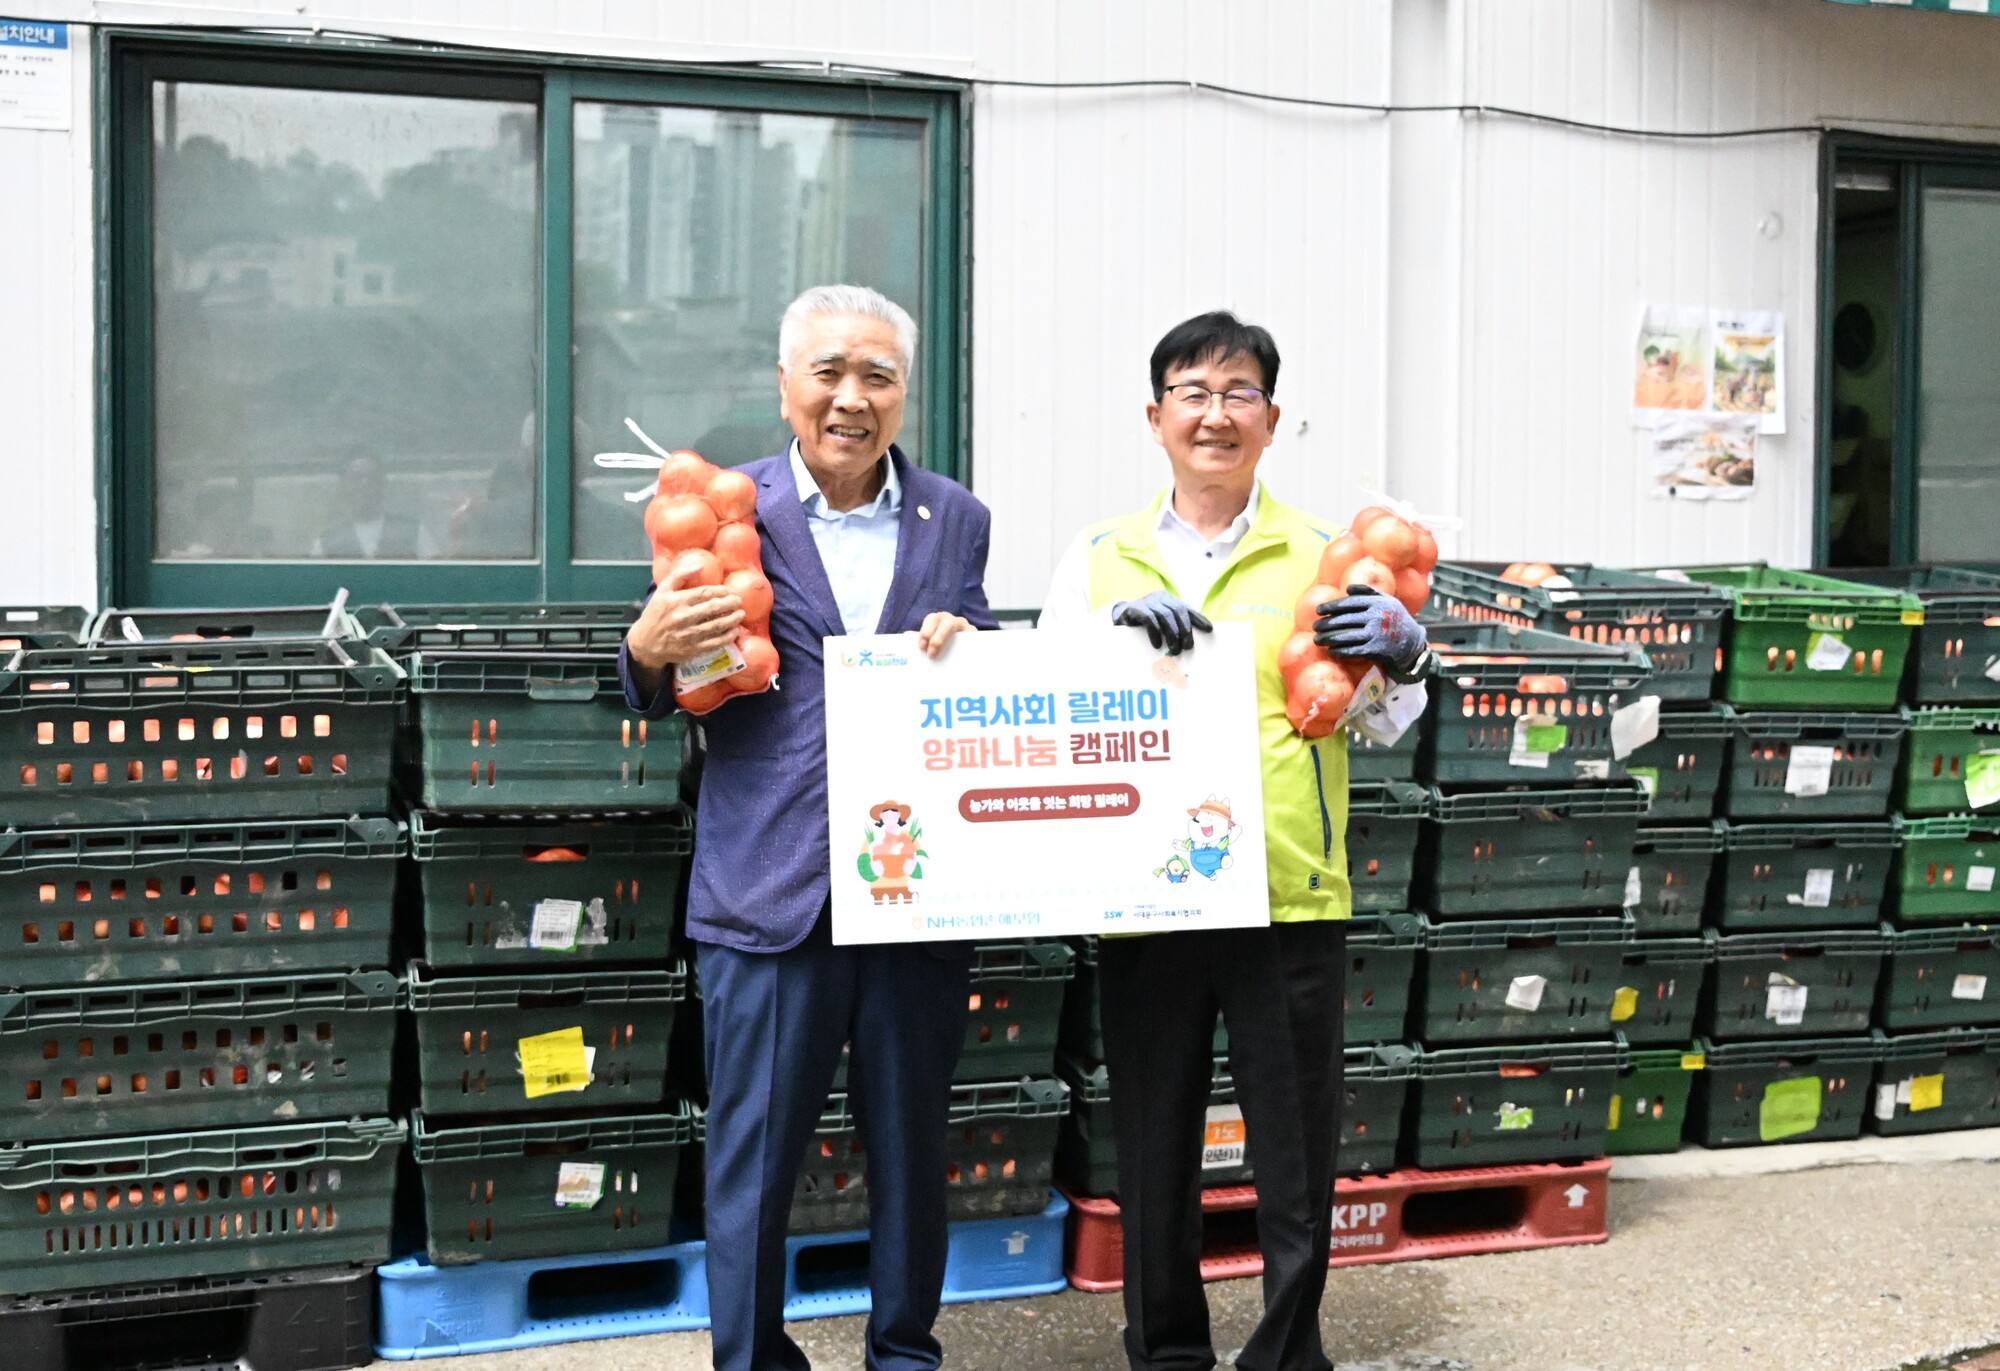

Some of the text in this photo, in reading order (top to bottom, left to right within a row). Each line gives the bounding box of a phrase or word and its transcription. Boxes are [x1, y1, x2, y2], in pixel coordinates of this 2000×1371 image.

[920, 688, 1168, 729] 지역사회 릴레이
[923, 729, 1171, 771] 양파나눔 캠페인
[969, 792, 1129, 813] 농가와 이웃을 잇는 희망 릴레이
[1104, 910, 1124, 919] SSW
[1331, 1202, 1387, 1230] KPP
